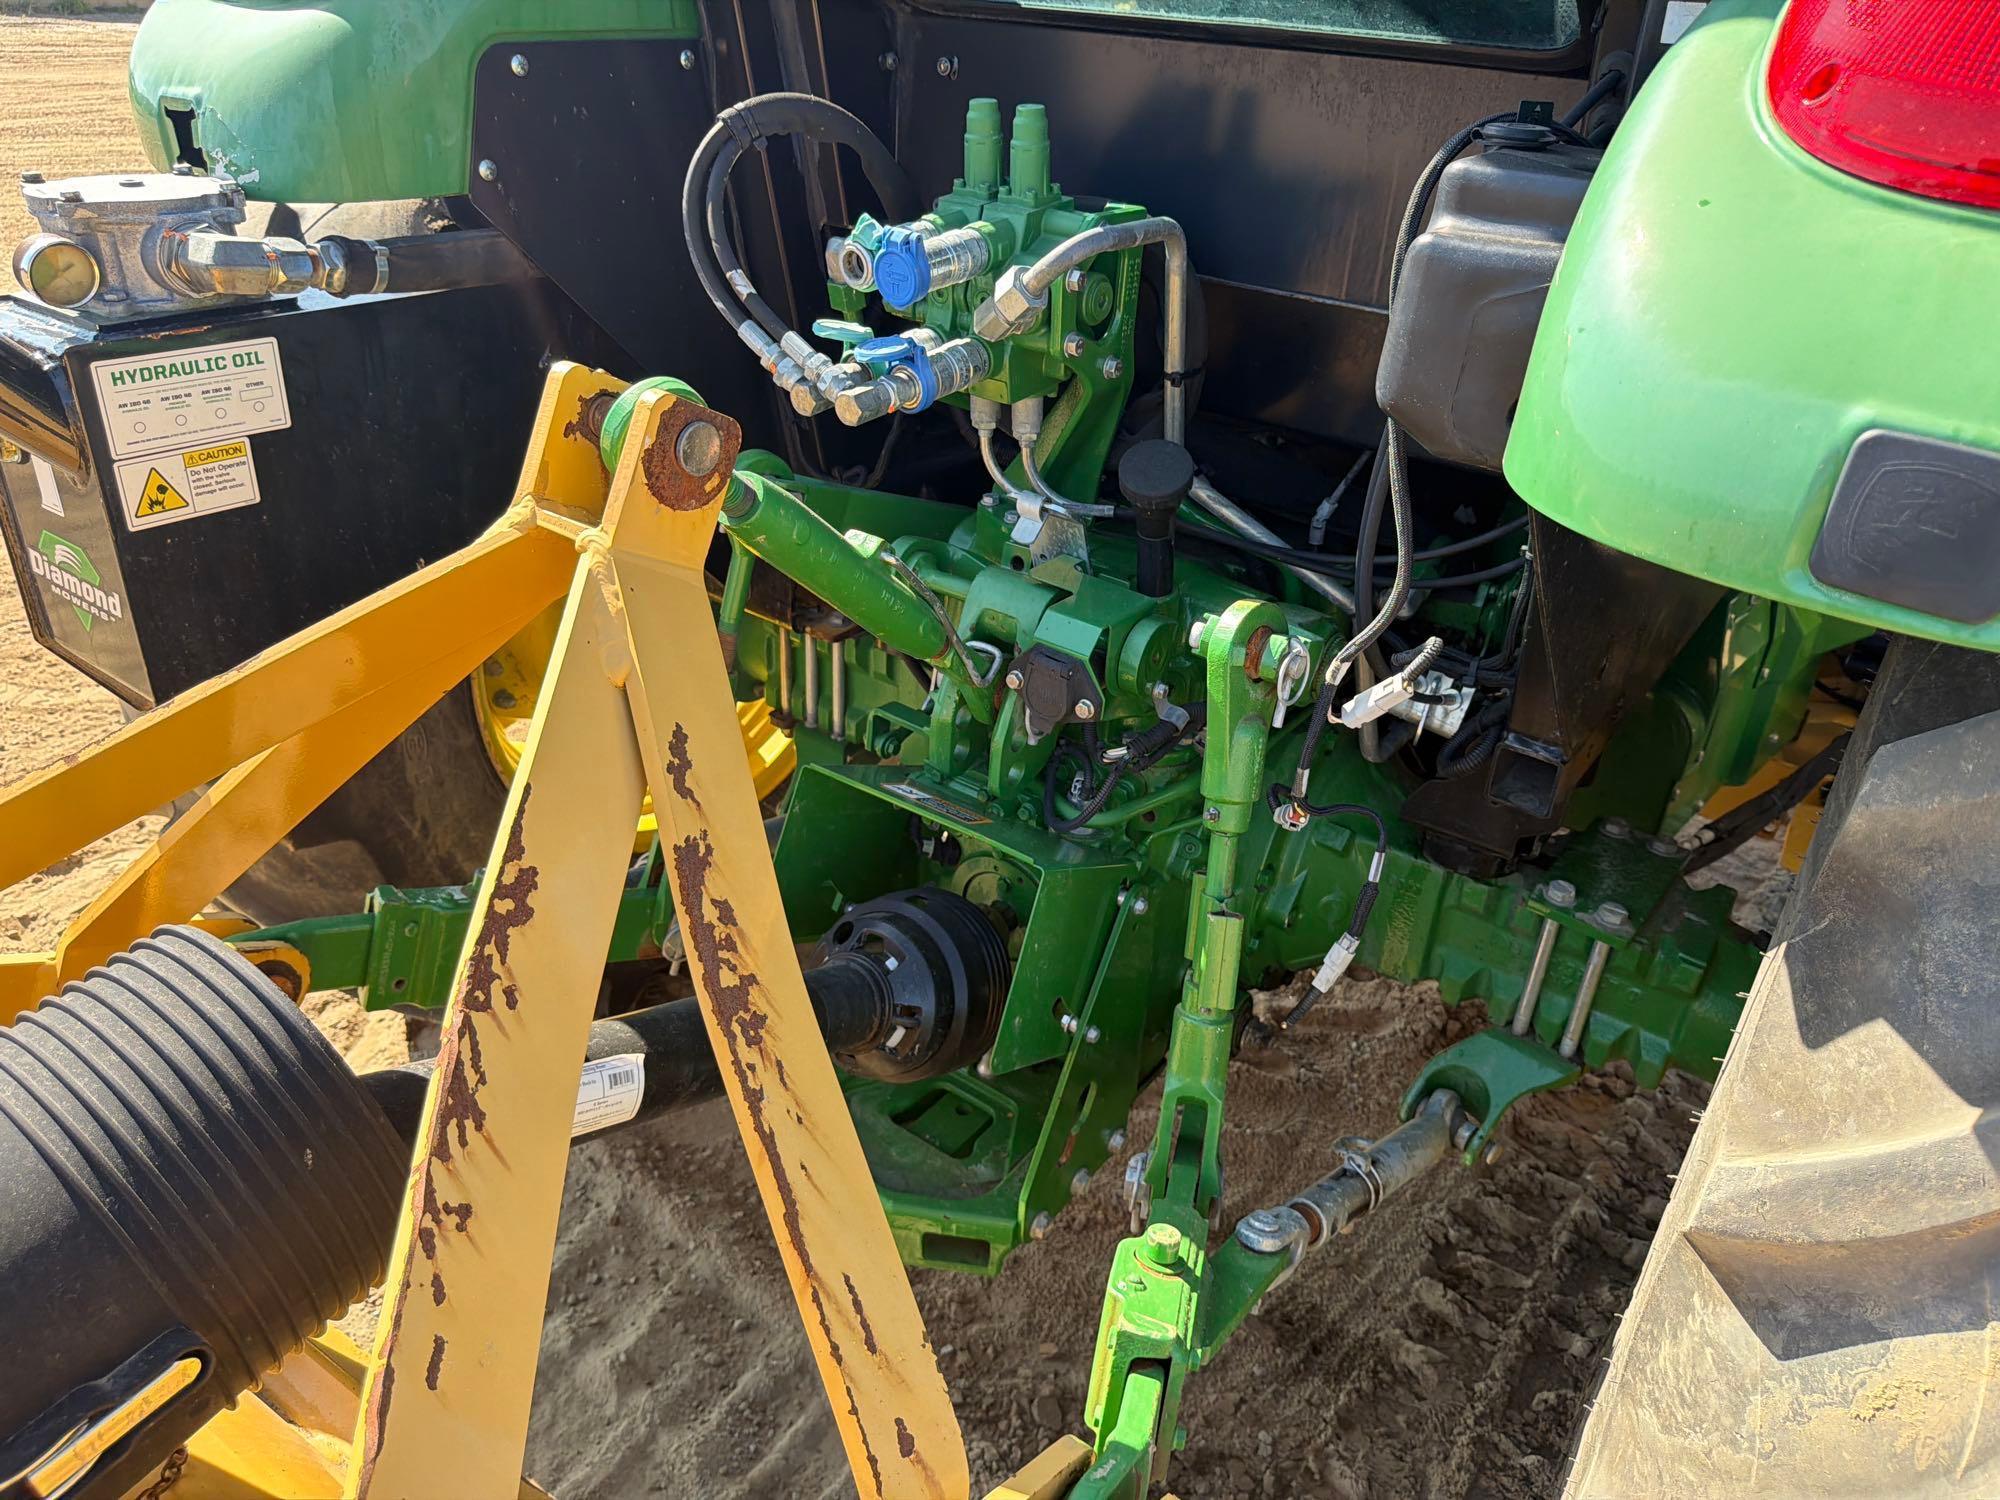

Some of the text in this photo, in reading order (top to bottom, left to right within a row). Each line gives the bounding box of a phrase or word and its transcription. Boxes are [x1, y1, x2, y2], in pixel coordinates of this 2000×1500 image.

[110, 355, 228, 387] HYDRAULIC
[232, 351, 265, 369] OIL
[198, 445, 242, 461] CAUTION
[218, 461, 246, 471] Operate
[27, 547, 122, 619] Diamond
[50, 584, 109, 622] MOWERS
